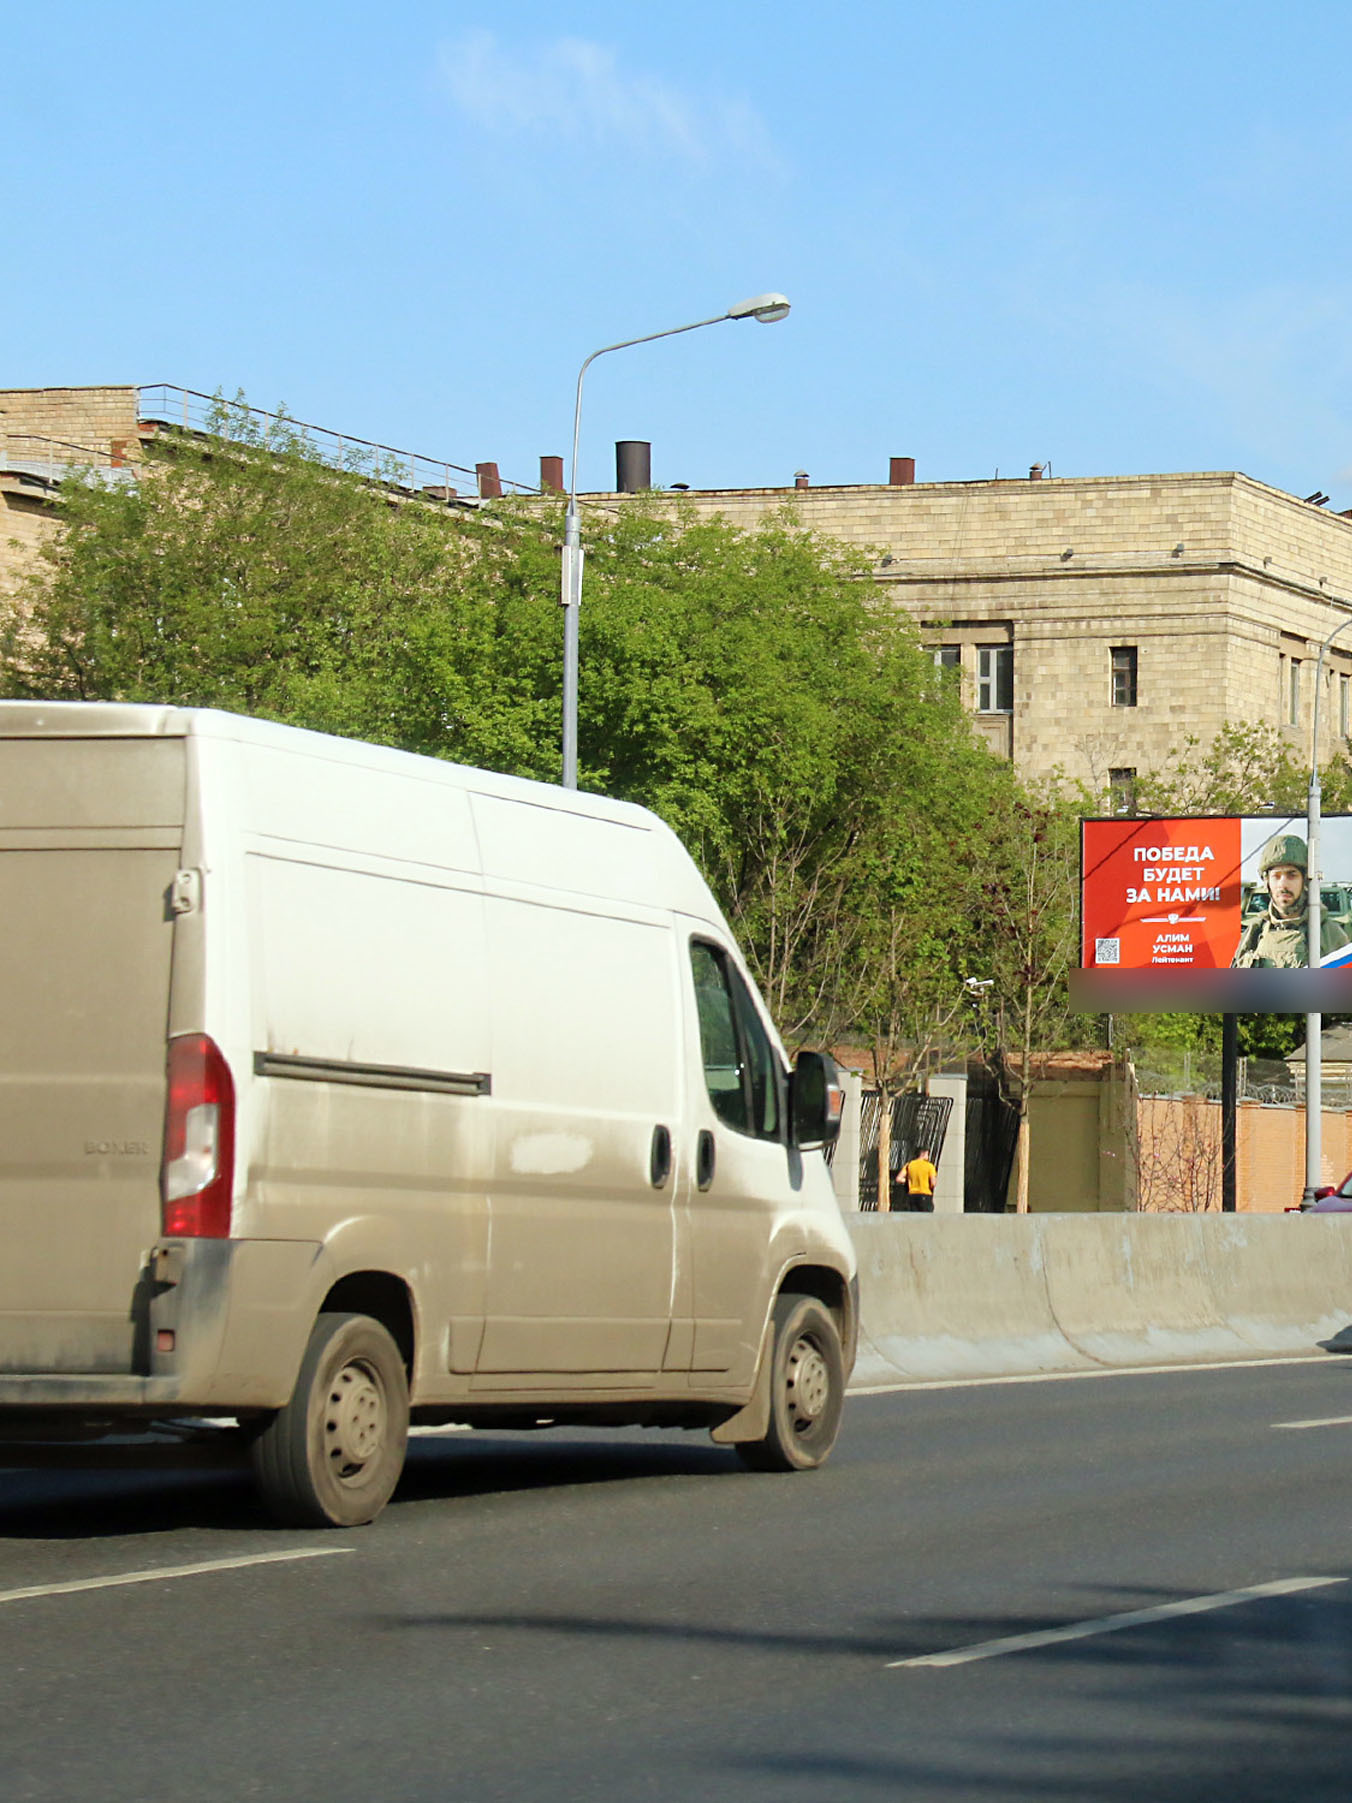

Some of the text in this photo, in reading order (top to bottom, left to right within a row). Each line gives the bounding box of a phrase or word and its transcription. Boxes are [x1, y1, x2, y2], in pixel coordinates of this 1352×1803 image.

[1134, 846, 1215, 862] ПОБЕДА
[1143, 867, 1205, 884] БУДЕТ
[1126, 887, 1221, 903] ЗА НАМИ!
[1156, 934, 1190, 943] АЛИМ
[1152, 944, 1193, 954] УСМАН
[1152, 956, 1194, 964] Лейтенант
